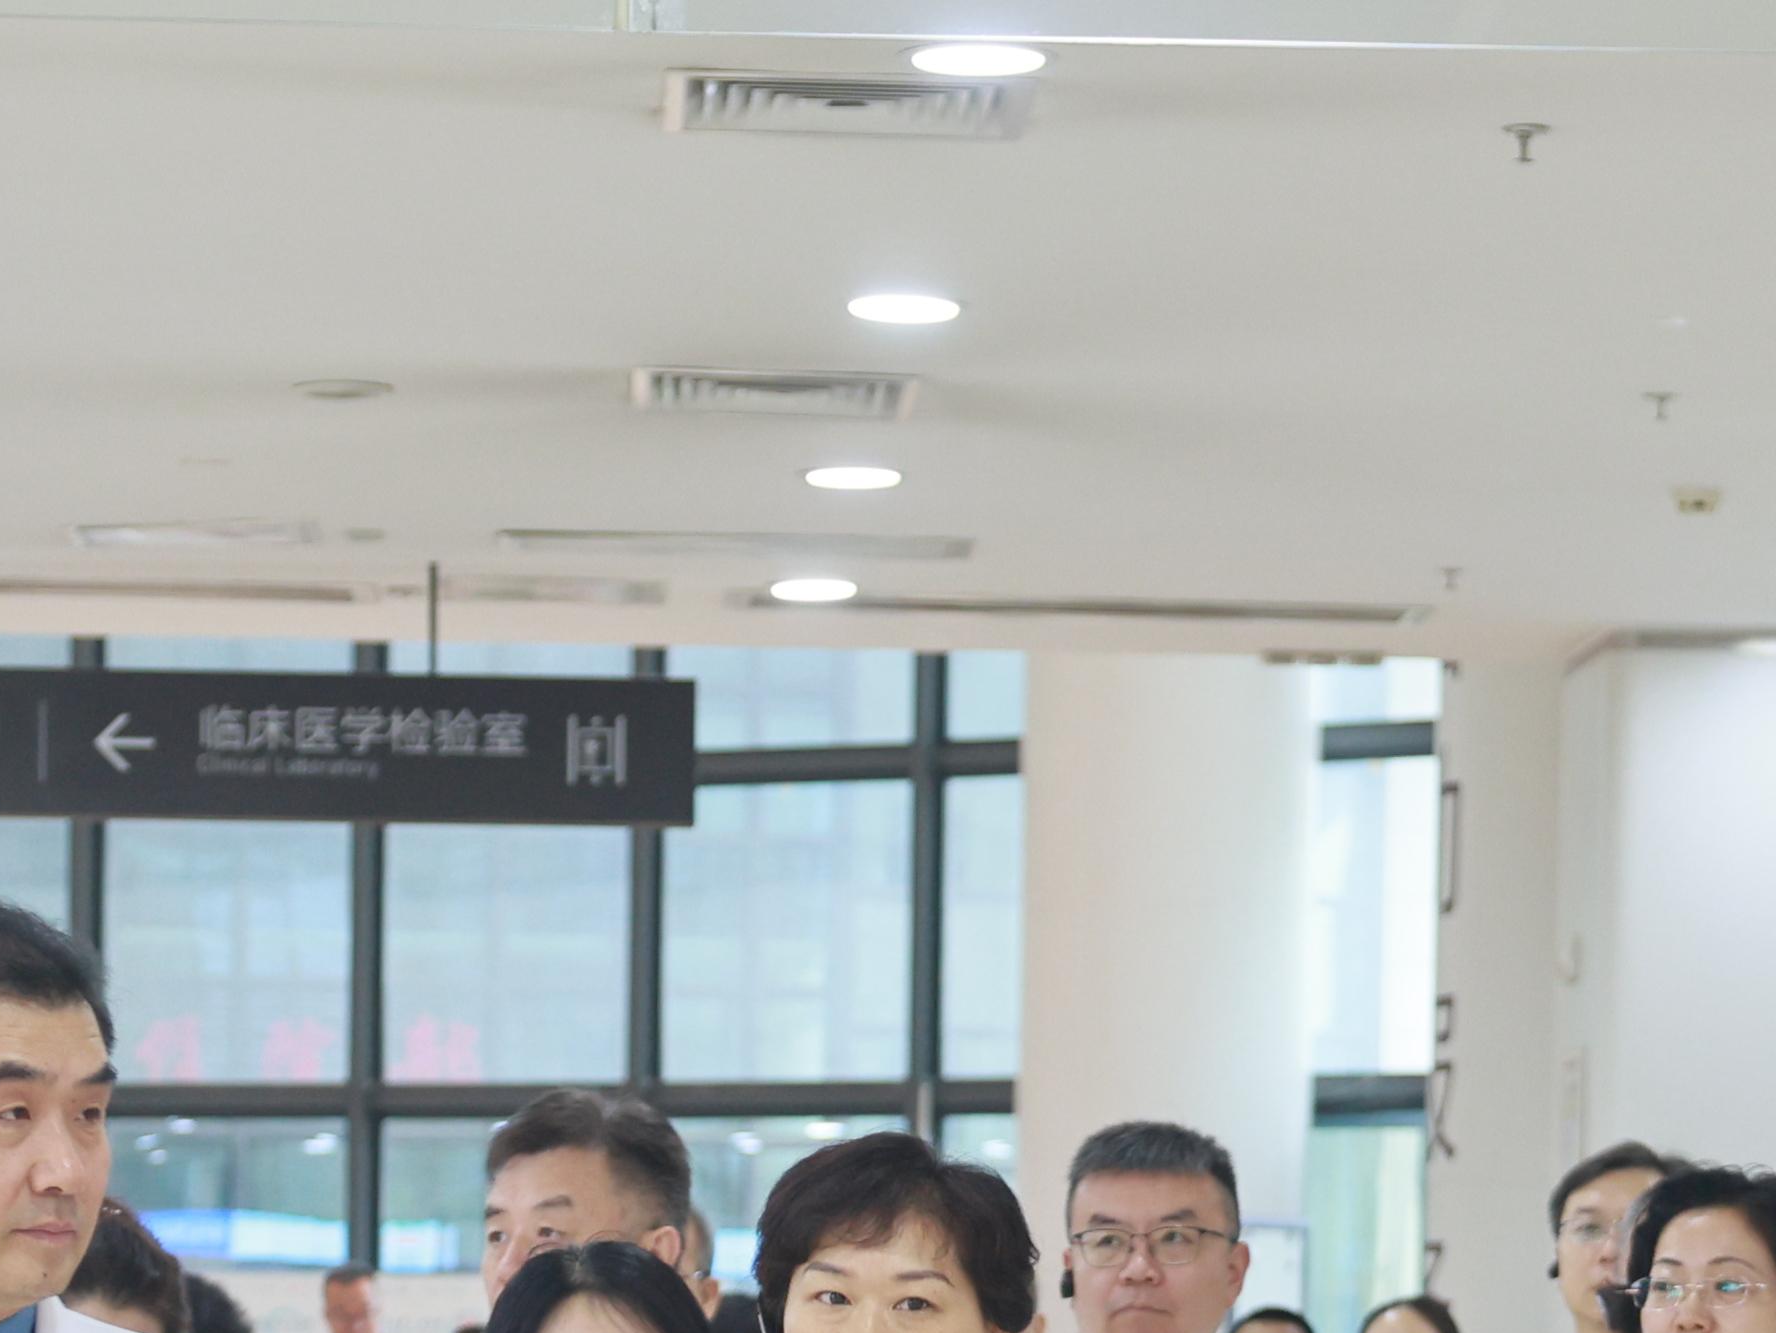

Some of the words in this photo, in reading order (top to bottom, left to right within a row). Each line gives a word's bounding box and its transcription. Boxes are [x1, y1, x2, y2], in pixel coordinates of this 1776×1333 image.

[197, 704, 527, 757] 临床医学检验室
